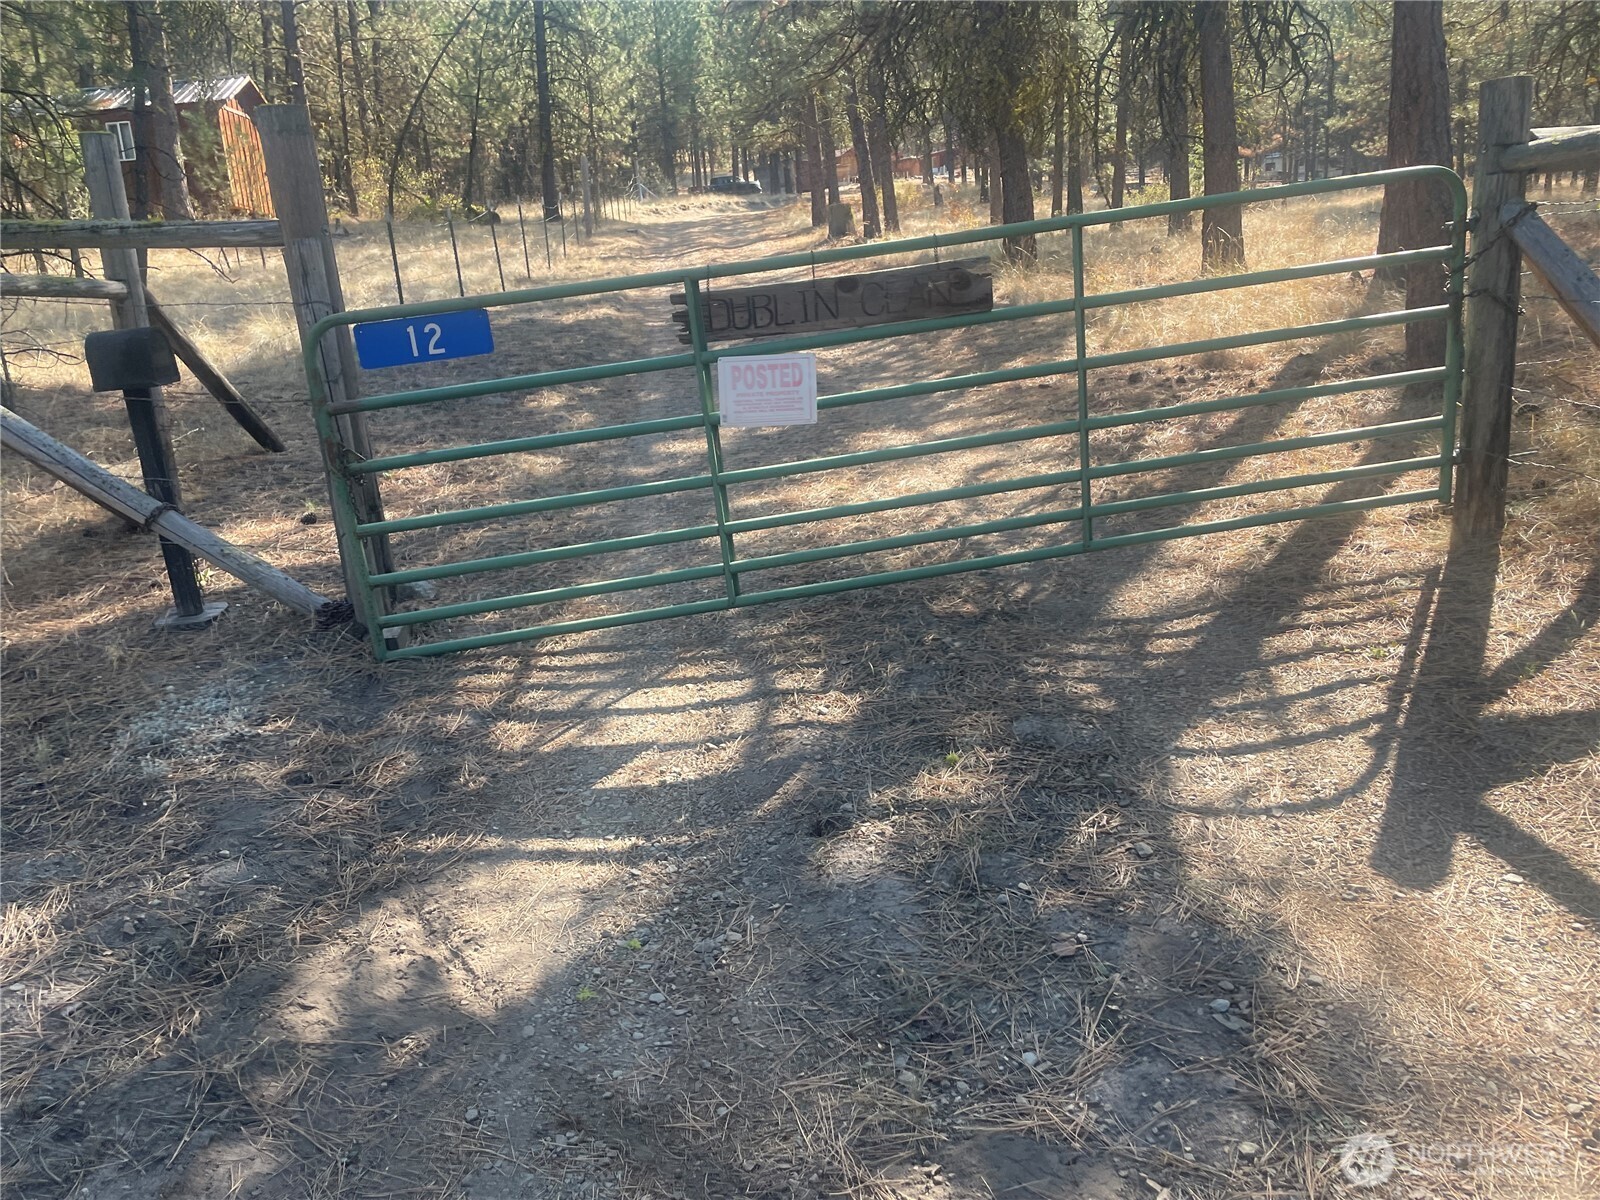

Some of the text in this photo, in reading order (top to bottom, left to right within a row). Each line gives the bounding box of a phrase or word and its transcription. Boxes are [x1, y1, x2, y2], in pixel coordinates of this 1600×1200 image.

[708, 287, 839, 332] DUBLIN
[406, 322, 446, 357] 12
[730, 362, 804, 391] POSTED
